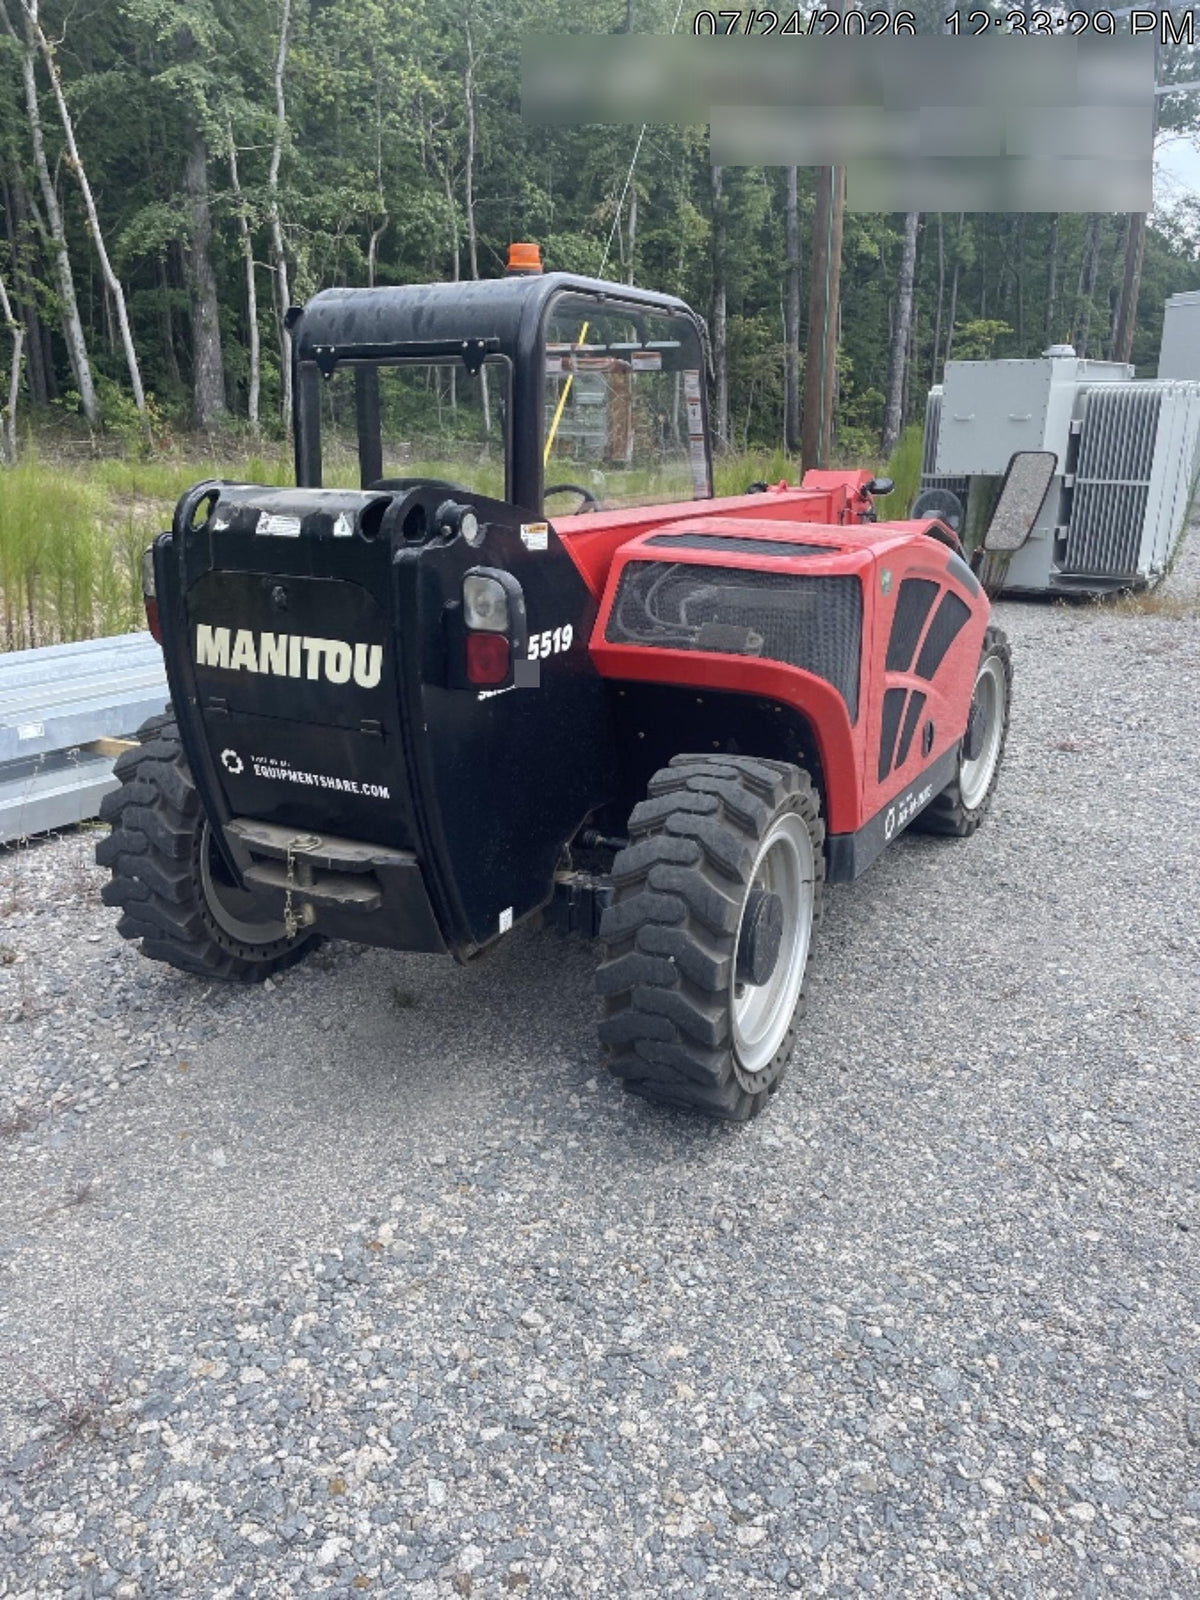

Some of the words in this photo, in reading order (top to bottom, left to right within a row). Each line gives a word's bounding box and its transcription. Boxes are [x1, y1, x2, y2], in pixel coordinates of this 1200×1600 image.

[195, 623, 383, 689] MANITOU
[527, 623, 574, 661] 5519
[253, 764, 391, 799] EQUIPMENTSHARE.COM
